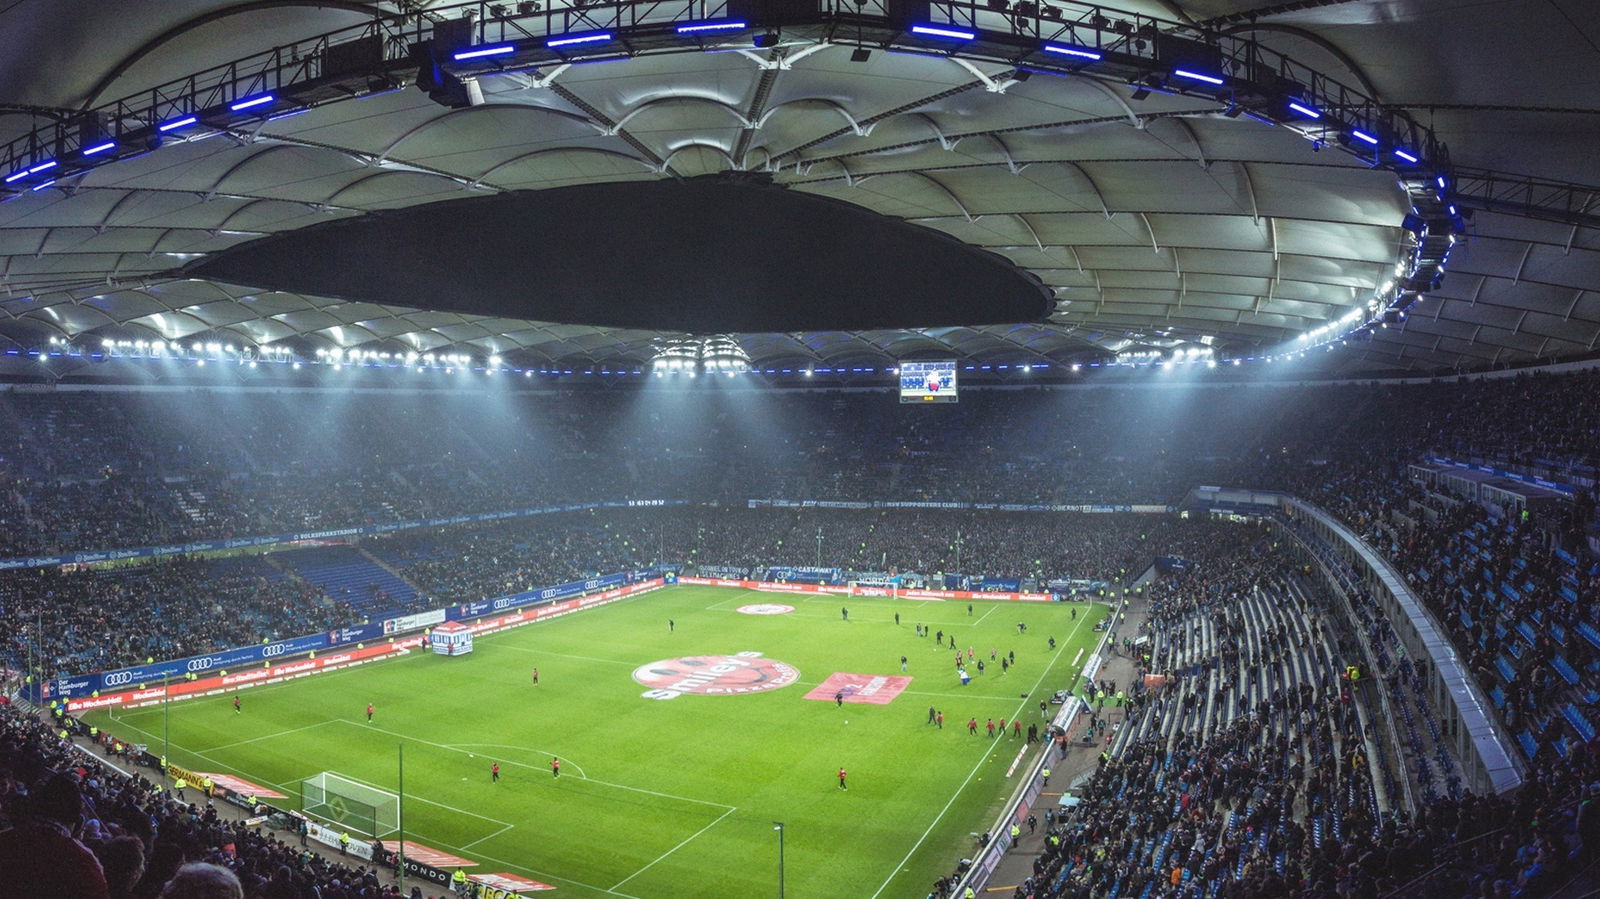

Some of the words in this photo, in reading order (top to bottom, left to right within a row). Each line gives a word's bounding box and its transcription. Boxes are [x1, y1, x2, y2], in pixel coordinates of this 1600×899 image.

[58, 681, 89, 691] Hamburger
[58, 688, 71, 696] Weg
[83, 696, 123, 709] Wochenblatt
